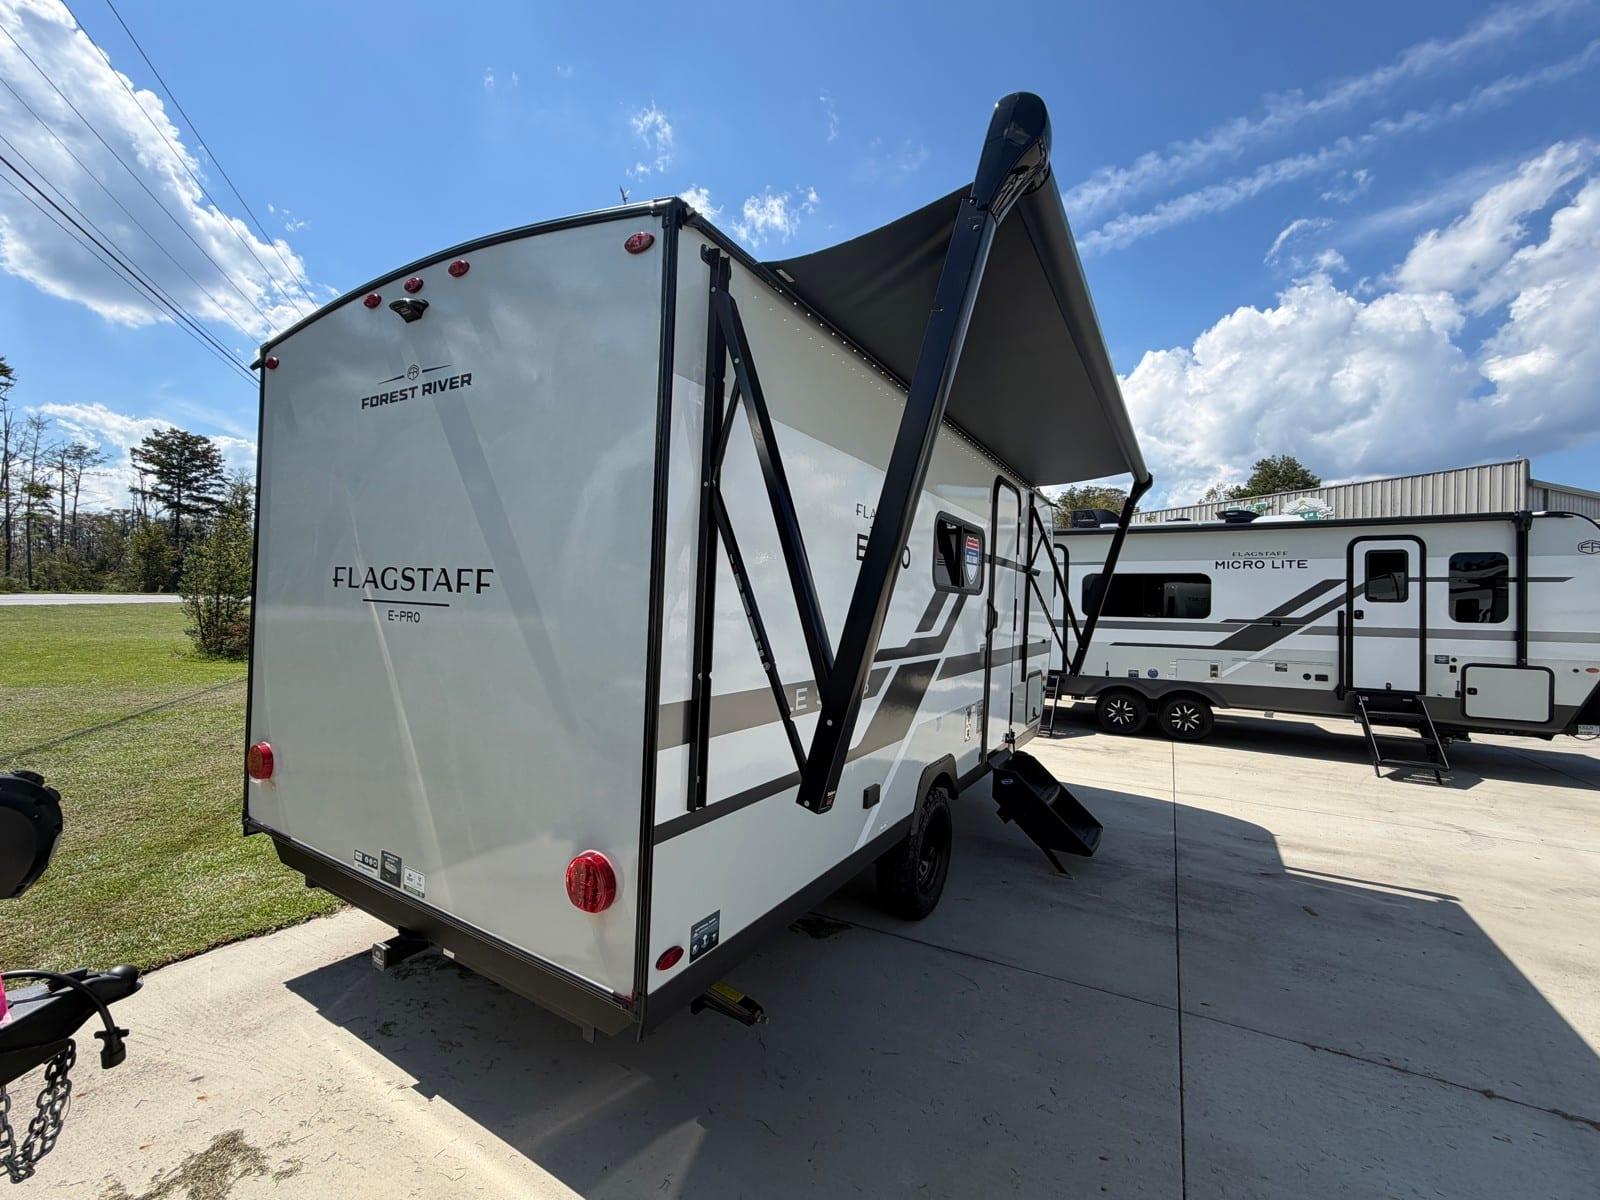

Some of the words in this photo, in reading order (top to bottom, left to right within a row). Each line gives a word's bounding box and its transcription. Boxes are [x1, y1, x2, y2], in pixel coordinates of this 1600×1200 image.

[361, 386, 419, 410] FOREST
[421, 373, 472, 396] RIVER
[1215, 560, 1265, 570] MICRO
[1271, 560, 1308, 569] LITE
[332, 566, 494, 594] FLAGSTAFF
[388, 610, 421, 623] E-PRO
